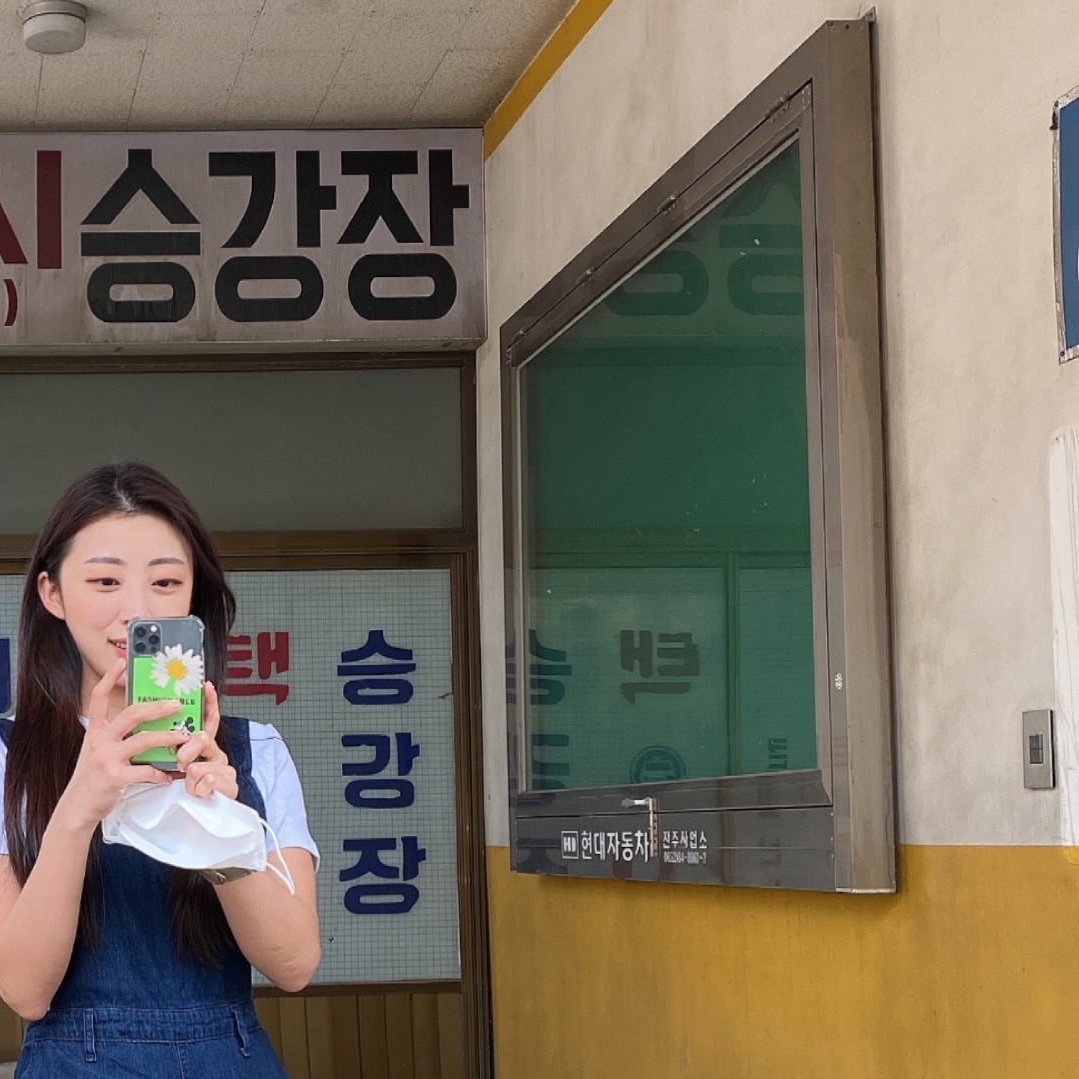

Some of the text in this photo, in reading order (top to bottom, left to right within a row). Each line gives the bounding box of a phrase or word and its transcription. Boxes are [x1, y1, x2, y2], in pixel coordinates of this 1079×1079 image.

[80, 149, 470, 322] 승강장
[581, 830, 650, 862] 현대자동차
[662, 830, 707, 849] 전주사업소
